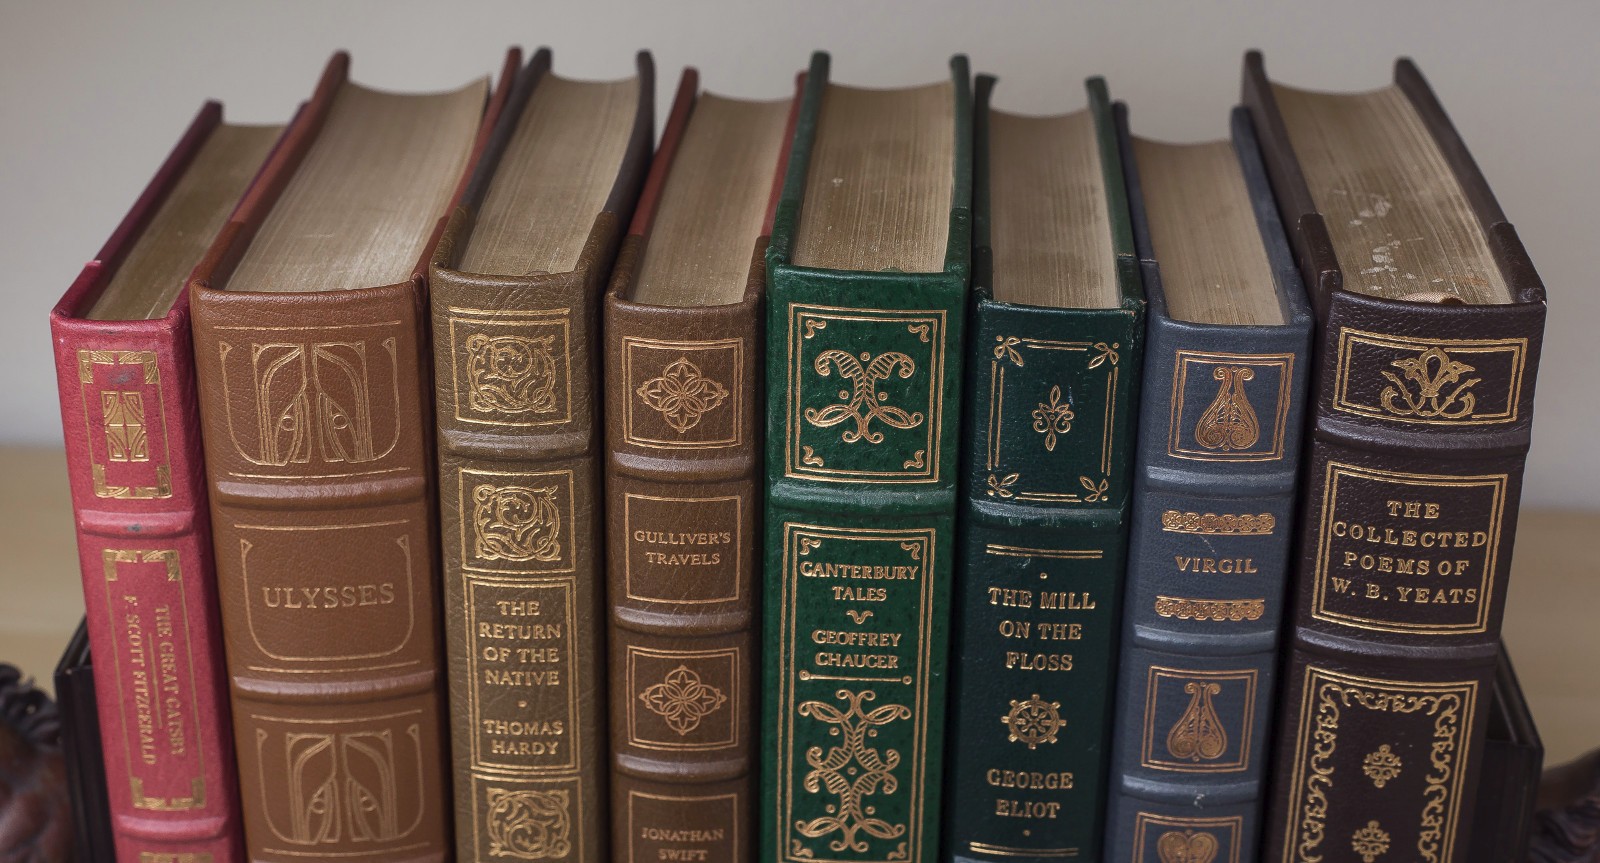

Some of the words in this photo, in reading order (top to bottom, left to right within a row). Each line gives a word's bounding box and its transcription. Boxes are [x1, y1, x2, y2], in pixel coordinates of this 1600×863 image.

[1387, 500, 1441, 519] THE
[633, 530, 731, 545] GULLIVER'S
[1332, 521, 1488, 547] COLLECTED
[645, 552, 721, 565] TRAVELS
[1175, 555, 1258, 574] VIRGIL
[1343, 551, 1429, 575] POEMS
[1437, 559, 1470, 575] OF
[799, 561, 919, 580] CANTERBURY
[262, 583, 395, 609] ULYSSES
[831, 586, 887, 602] TALES
[988, 586, 1032, 609] THE
[1040, 591, 1096, 611] MILL
[1331, 576, 1356, 595] W.
[1366, 584, 1389, 600] B.
[1397, 586, 1478, 604] YEATS
[497, 600, 541, 617] THE
[155, 604, 172, 637] THE
[479, 621, 562, 640] RETURN
[811, 629, 902, 647] GEOFFREY
[999, 620, 1030, 639] ON
[1038, 623, 1083, 641] THE
[126, 614, 145, 667] SCOTT
[484, 647, 512, 662] OF
[516, 647, 560, 663] THE
[815, 652, 899, 670] CHAUCER
[1005, 651, 1073, 671] FLOSS
[160, 641, 179, 695] GREAT
[485, 670, 560, 687] NATIVE
[133, 671, 156, 765] FITZGERALD
[166, 696, 185, 757] GATSBY
[483, 719, 564, 736] THOMAS
[491, 740, 560, 755] HARDY
[986, 768, 1074, 789] GEORGE
[995, 799, 1061, 819] ELIOT
[641, 826, 724, 841] JONATHAN
[658, 848, 708, 862] SWIFT
